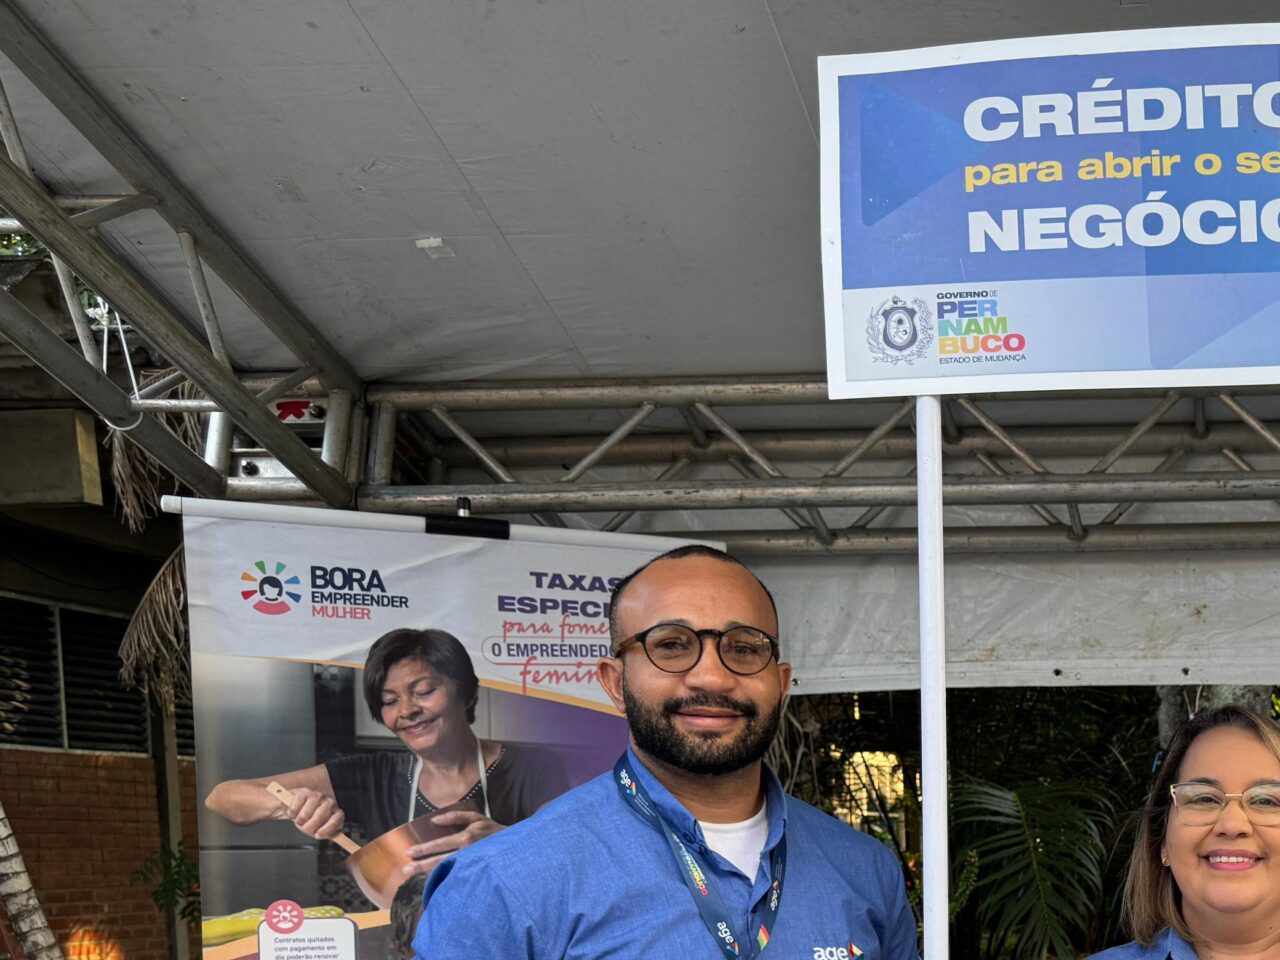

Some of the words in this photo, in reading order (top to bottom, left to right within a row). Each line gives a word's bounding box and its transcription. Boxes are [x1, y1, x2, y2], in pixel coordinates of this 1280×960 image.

[964, 160, 1063, 192] para
[1077, 149, 1180, 180] abrir
[1194, 152, 1222, 175] o
[936, 290, 988, 300] GOVERNO
[989, 289, 998, 297] DE
[936, 299, 999, 319] PER
[938, 316, 1008, 336] NAM
[938, 333, 1026, 355] BUCO
[939, 356, 971, 365] ESTADO
[972, 355, 984, 363] DE
[984, 353, 1027, 362] MUDANÇA
[310, 565, 387, 593] BORA
[311, 592, 409, 609] EMPREENDER
[311, 606, 372, 620] MULHER
[502, 620, 554, 643] para
[491, 643, 502, 657] O
[716, 920, 734, 944] age
[286, 953, 313, 960] poderão
[290, 945, 326, 953] pagamento
